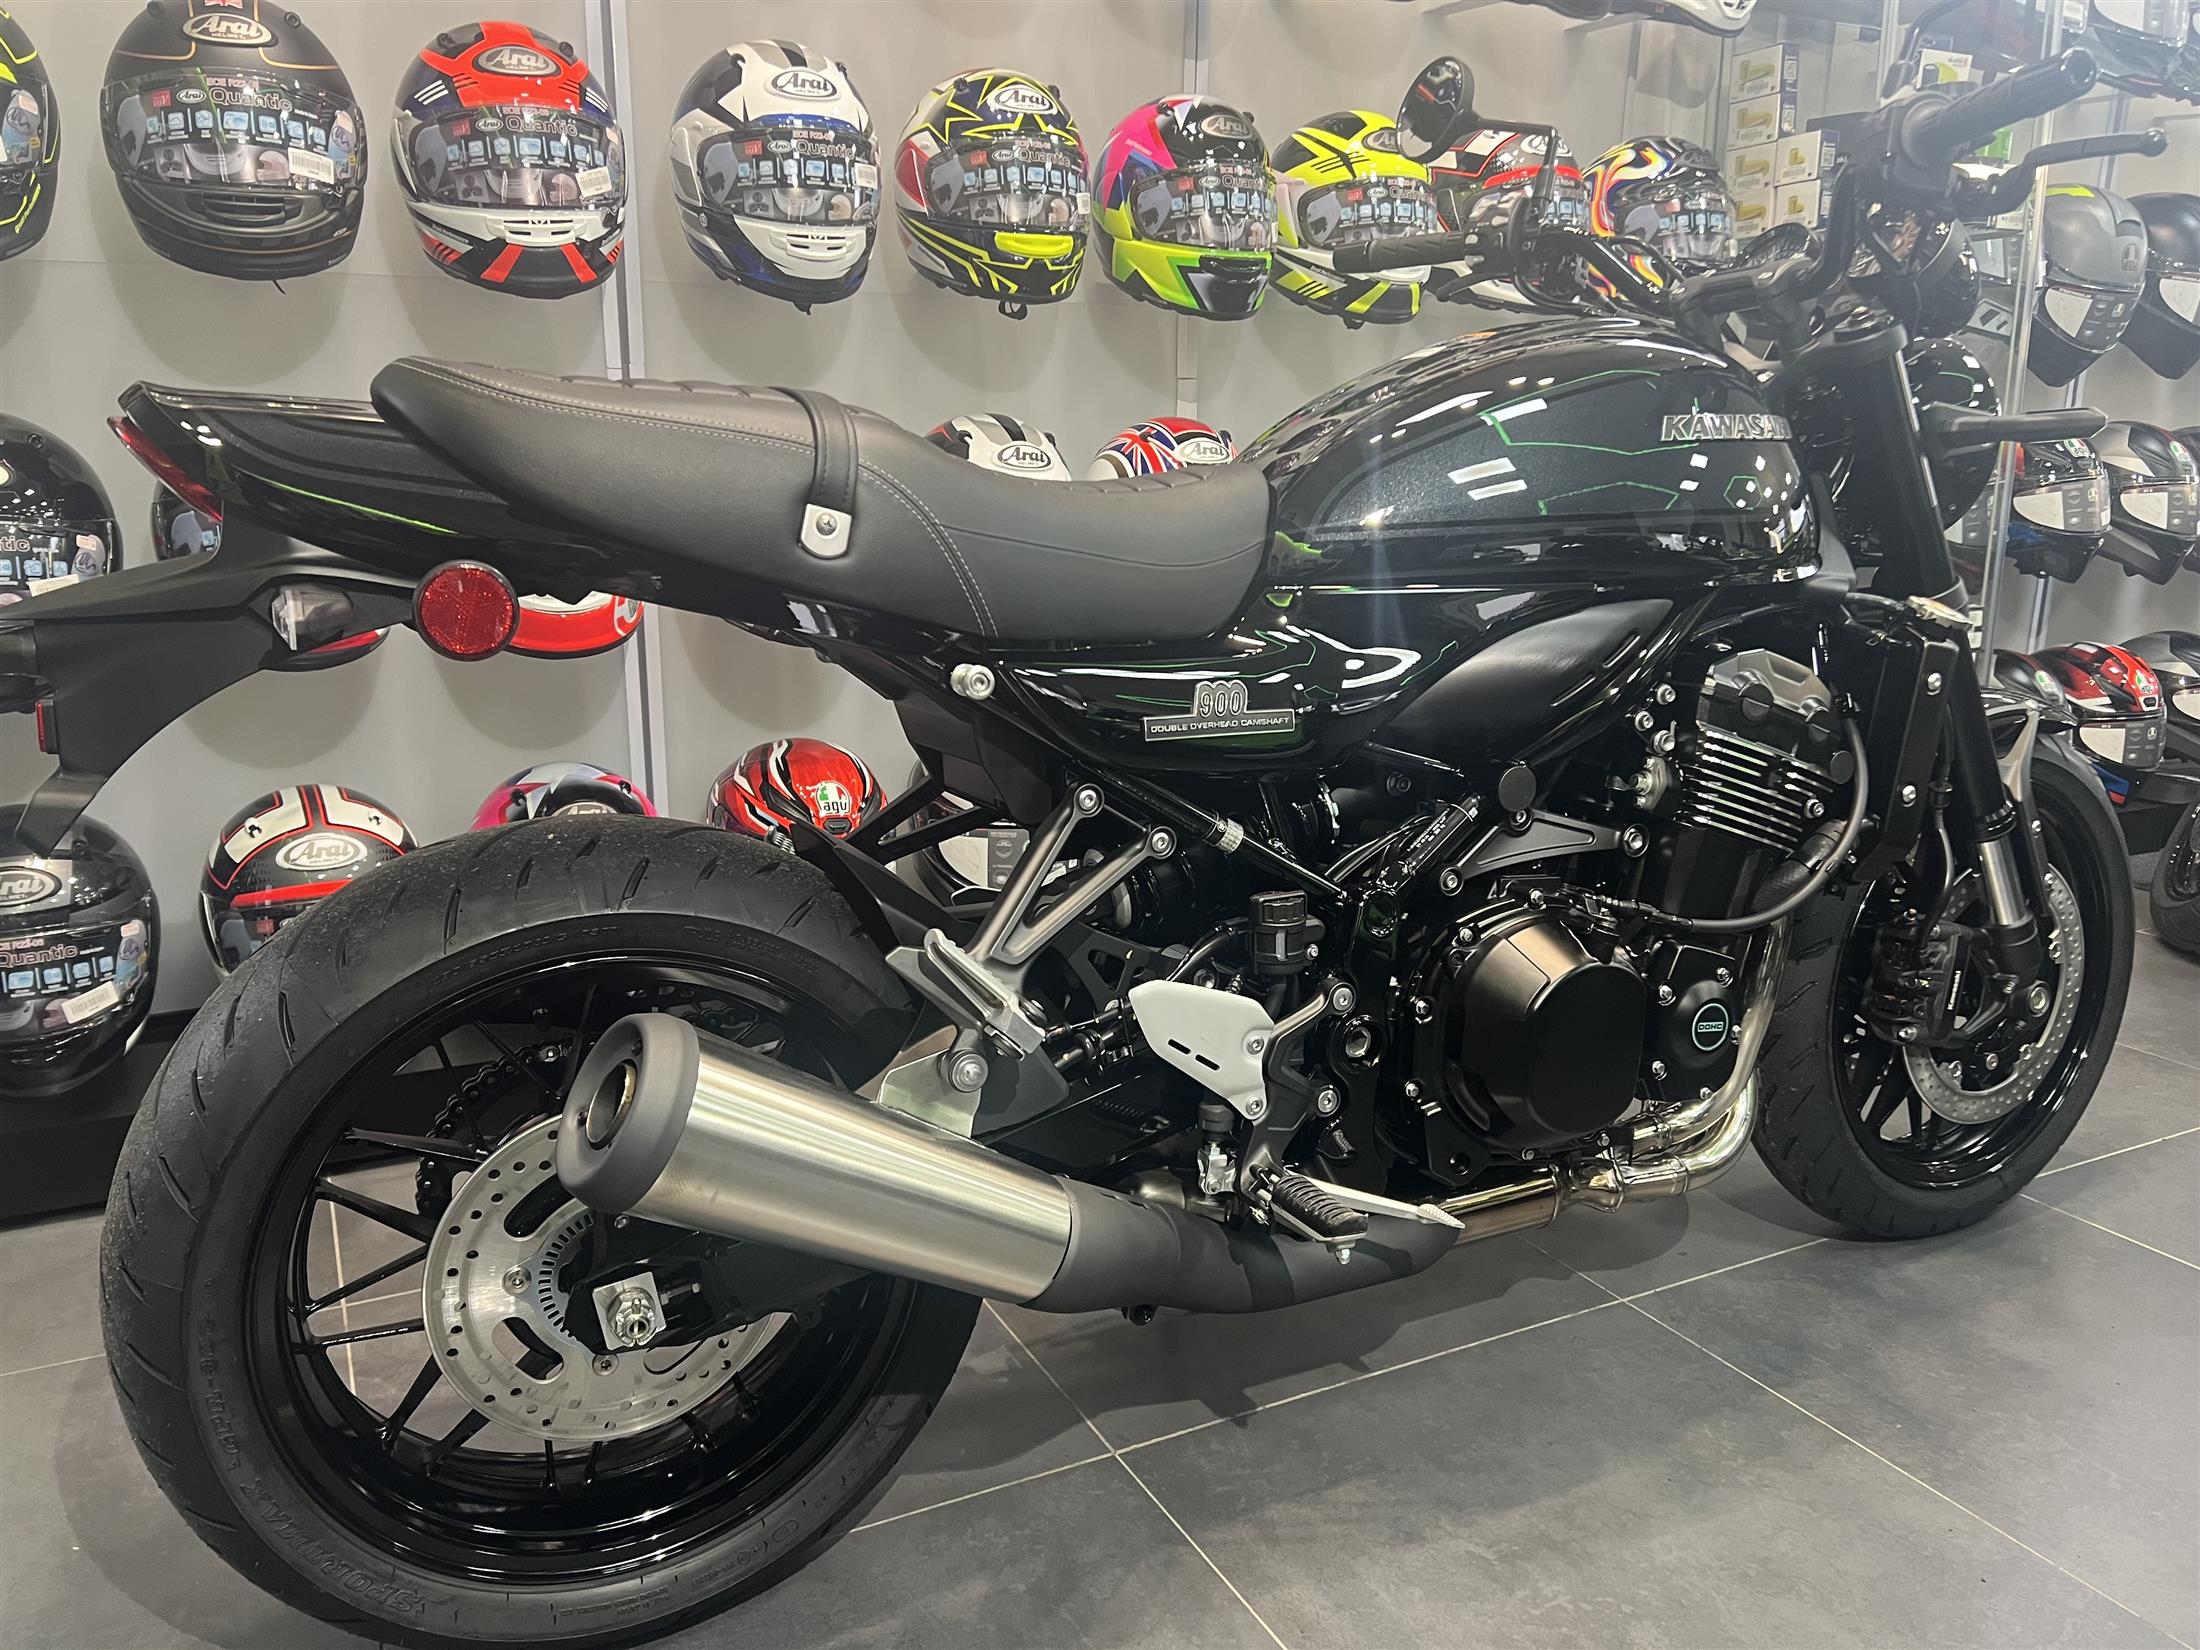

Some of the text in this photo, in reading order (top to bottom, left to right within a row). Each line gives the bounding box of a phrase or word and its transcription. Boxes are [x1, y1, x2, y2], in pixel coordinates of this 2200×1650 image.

[190, 15, 260, 37] Arai
[487, 48, 547, 68] Arai
[777, 72, 831, 91] Arai
[180, 90, 204, 101] Arai
[209, 86, 293, 113] Quantic
[1000, 89, 1047, 106] Arai
[477, 119, 500, 130] Arai
[504, 114, 578, 137] Quantic
[1206, 116, 1249, 134] Arai
[769, 141, 791, 150] Arai
[795, 138, 856, 159] Quantic
[1660, 412, 1793, 442] KAWASAK
[1002, 446, 1046, 463] Arai
[1187, 442, 1225, 456] Arai
[1199, 690, 1244, 718] 900
[1150, 717, 1290, 734] DOUBLE OVERHEAD CAMSHAFT
[822, 801, 848, 814] agv
[289, 841, 352, 864] Arai
[0, 875, 44, 896] rai
[0, 944, 79, 968] Quantic
[1698, 1023, 1723, 1031] DOHC
